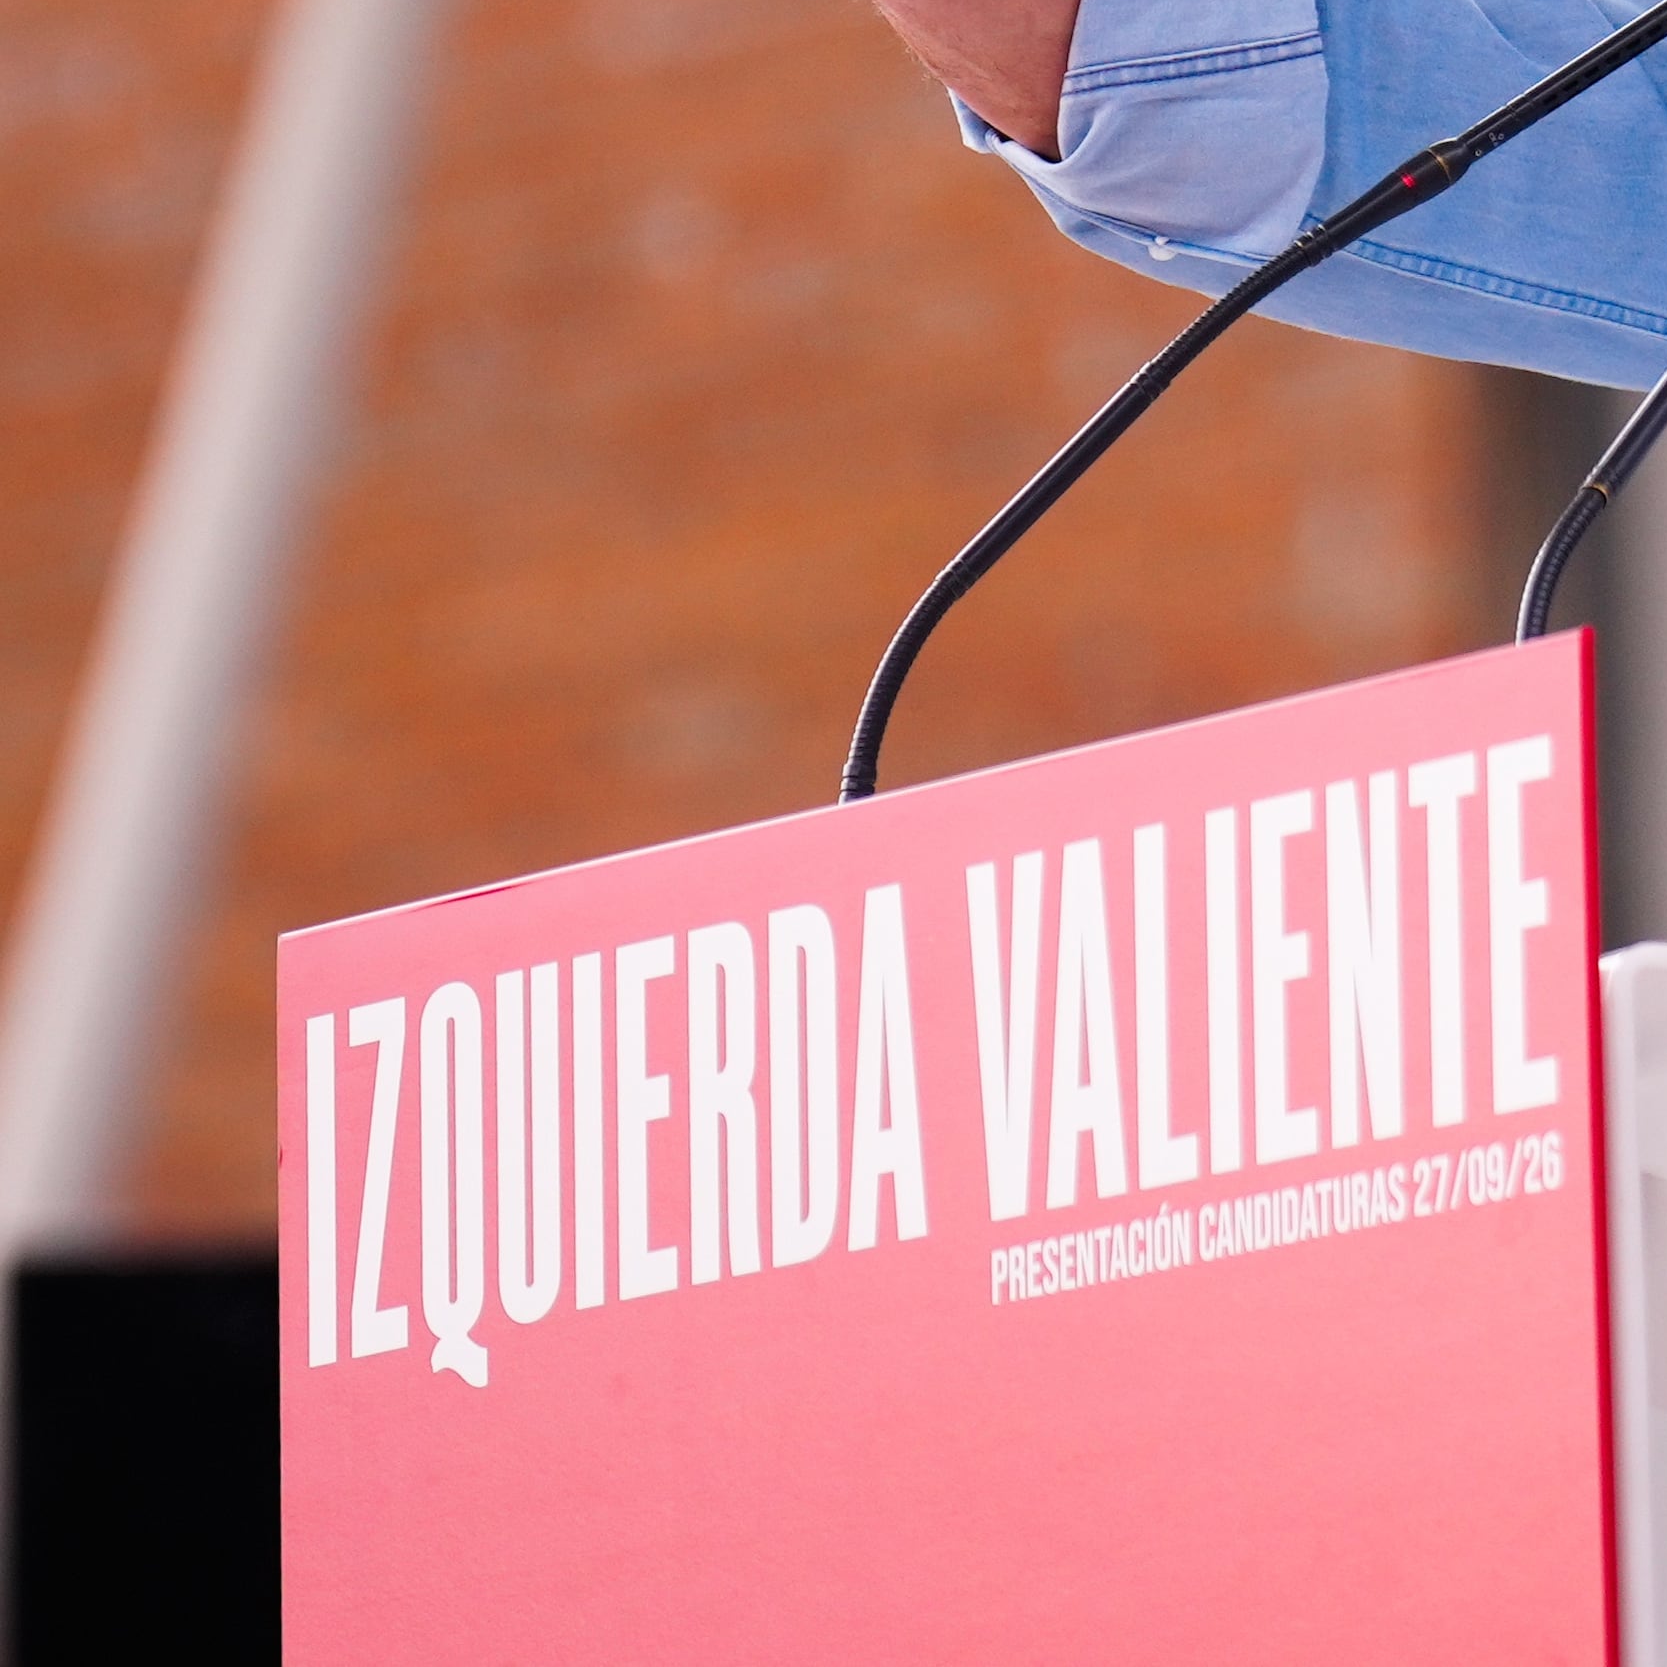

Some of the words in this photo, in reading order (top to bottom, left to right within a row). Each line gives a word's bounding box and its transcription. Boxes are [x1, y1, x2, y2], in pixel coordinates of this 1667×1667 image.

[305, 880, 928, 1388] IZQUIERDA
[964, 733, 1561, 1222] VALIENTE
[991, 1203, 1193, 1305] PRESENTACIÓN
[1198, 1164, 1409, 1262] CANDIDATURAS
[1412, 1130, 1563, 1217] 27/09/26
